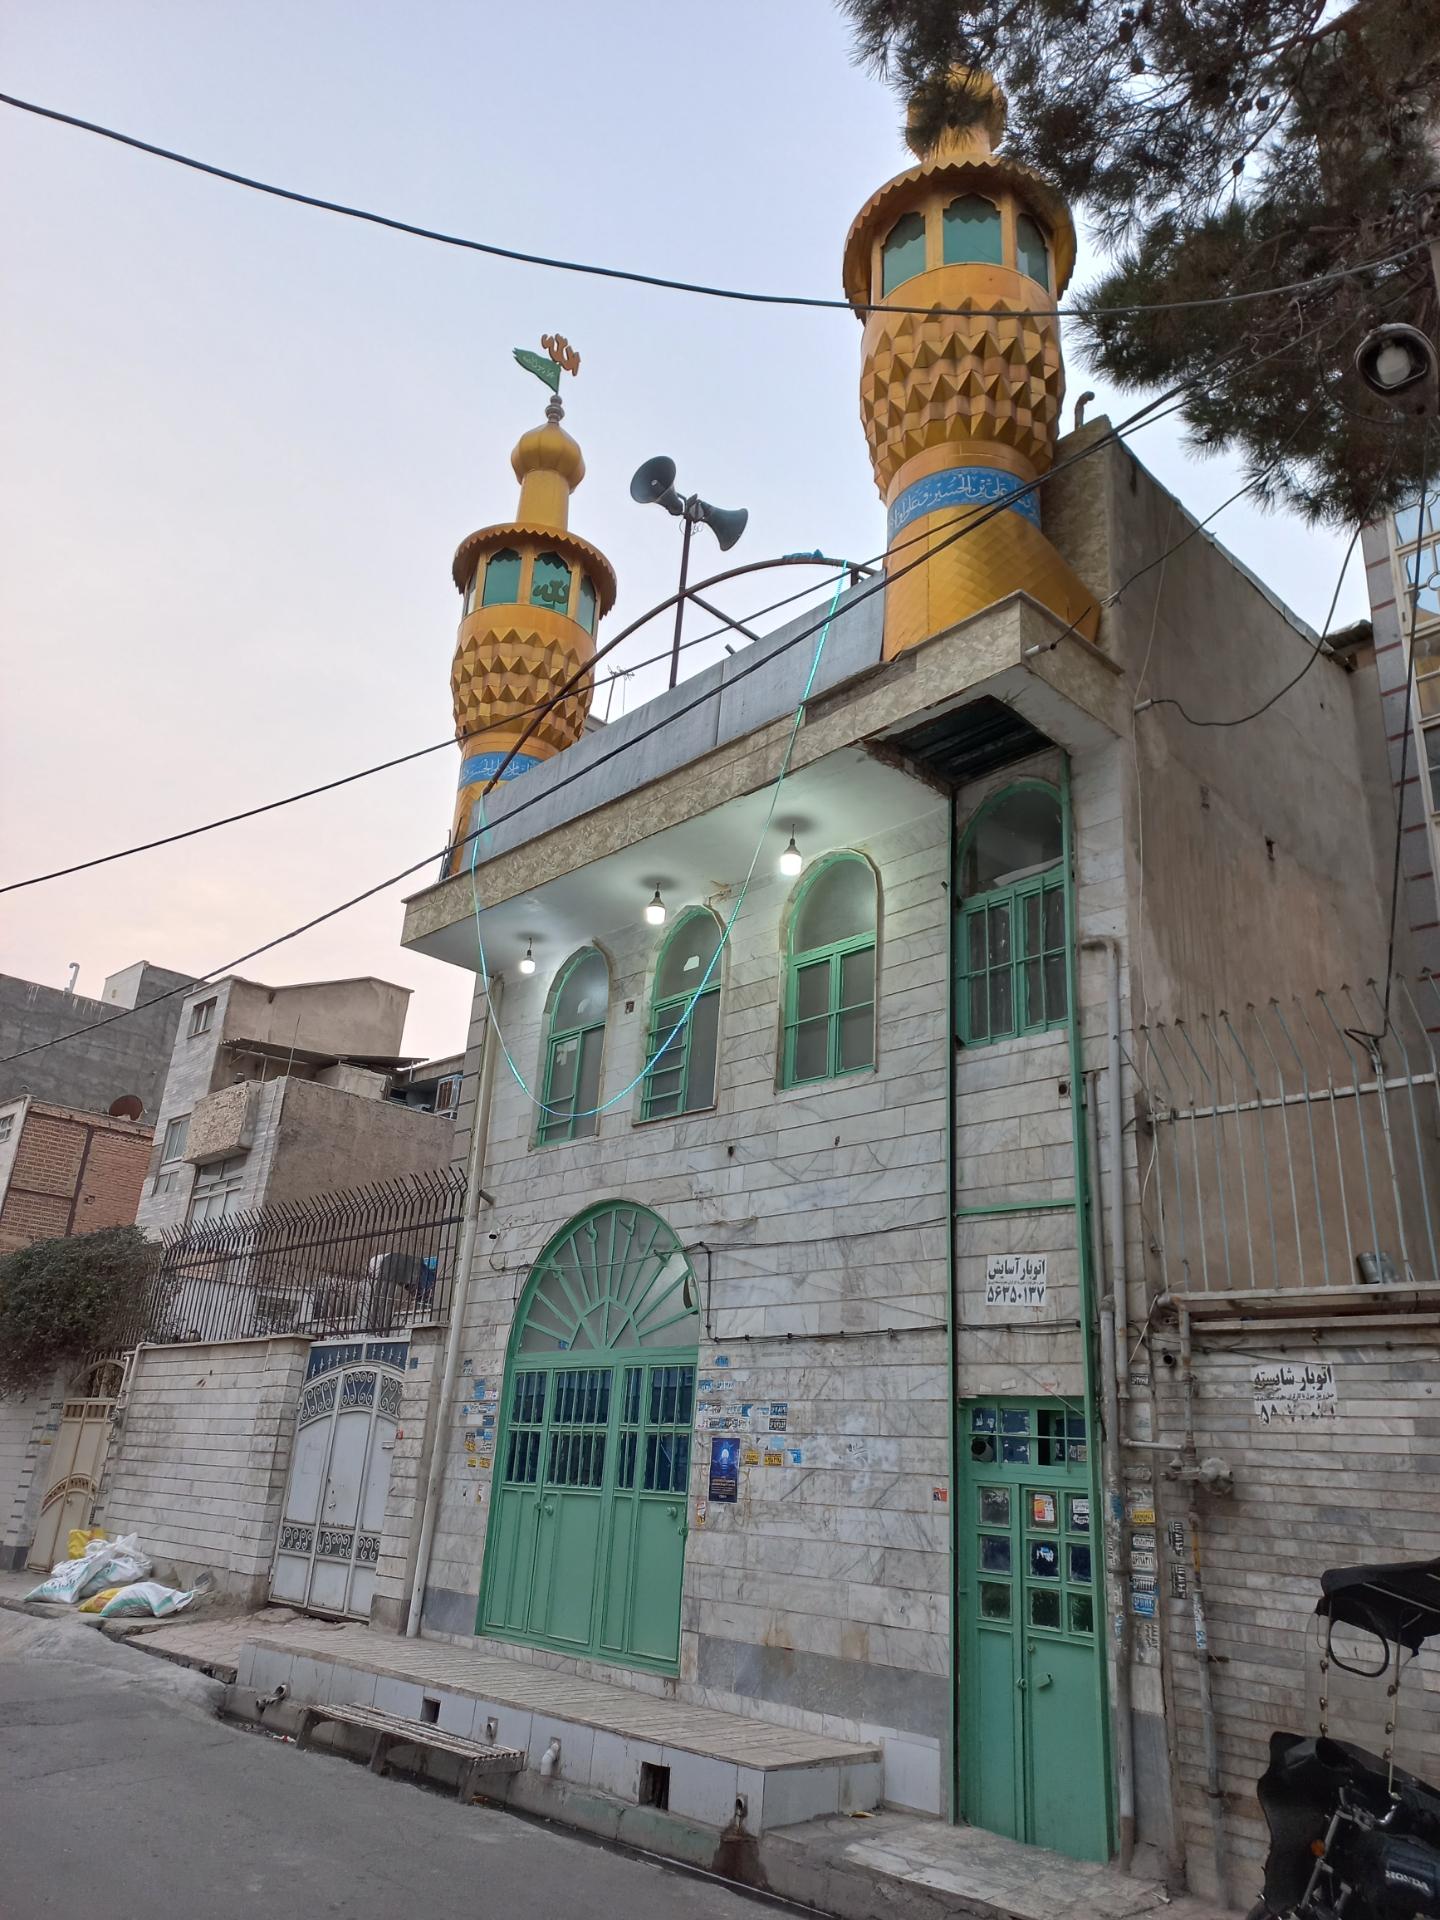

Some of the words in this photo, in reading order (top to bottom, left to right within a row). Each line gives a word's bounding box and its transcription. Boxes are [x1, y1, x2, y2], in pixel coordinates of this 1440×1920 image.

[988, 1257, 1021, 1280] آسایش
[1020, 1259, 1046, 1280] اتوبار
[1253, 1367, 1295, 1391] شایسته
[1298, 1365, 1332, 1391] اتوبار
[1385, 1869, 1434, 1896] HONDA
